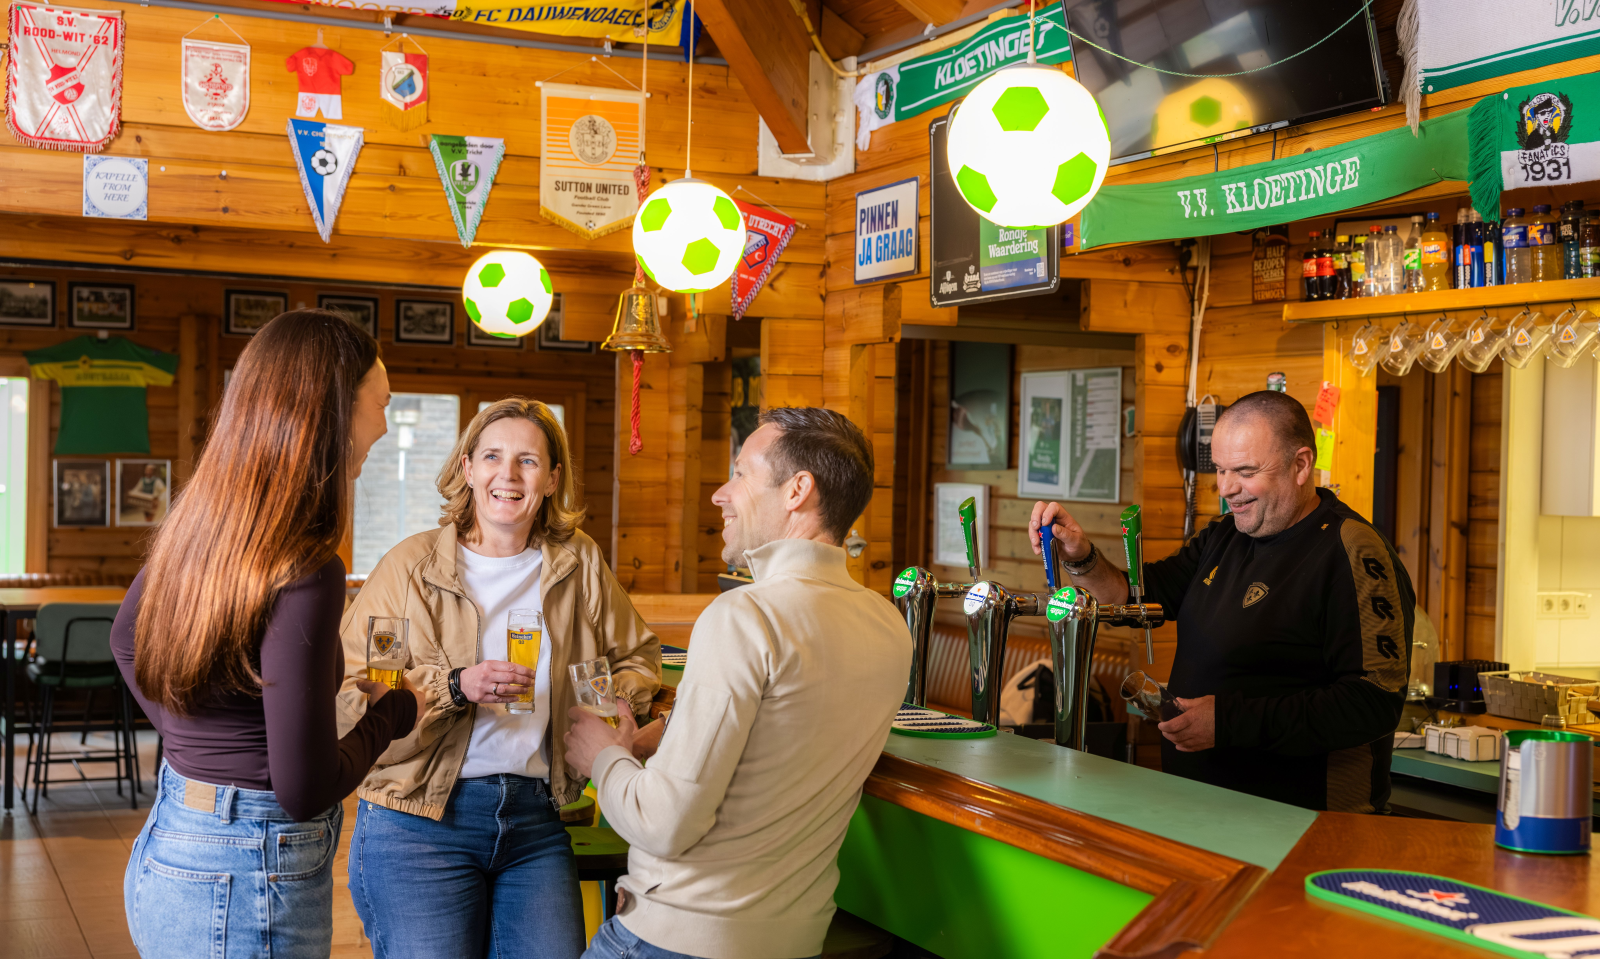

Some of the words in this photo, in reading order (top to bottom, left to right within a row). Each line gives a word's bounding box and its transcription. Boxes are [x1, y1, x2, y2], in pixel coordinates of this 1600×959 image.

[57, 16, 77, 28] S.V.
[474, 9, 501, 22] FC
[506, 6, 643, 26] DAUWENDAELE
[24, 26, 86, 43] ROOD-WIT
[95, 171, 139, 182] KAPELLE
[1521, 157, 1571, 182] 1931
[103, 182, 132, 192] FROM
[555, 180, 593, 193] SUTTON
[596, 183, 630, 196] UNITED
[1177, 188, 1214, 219] V.V.
[1221, 156, 1361, 214] KLOETINGE
[103, 193, 129, 202] HERE
[748, 214, 786, 239] UTRECHT
[859, 199, 899, 237] PINNEN
[858, 236, 872, 267] JA
[875, 227, 913, 263] GRAAG
[988, 239, 1039, 259] Waardering
